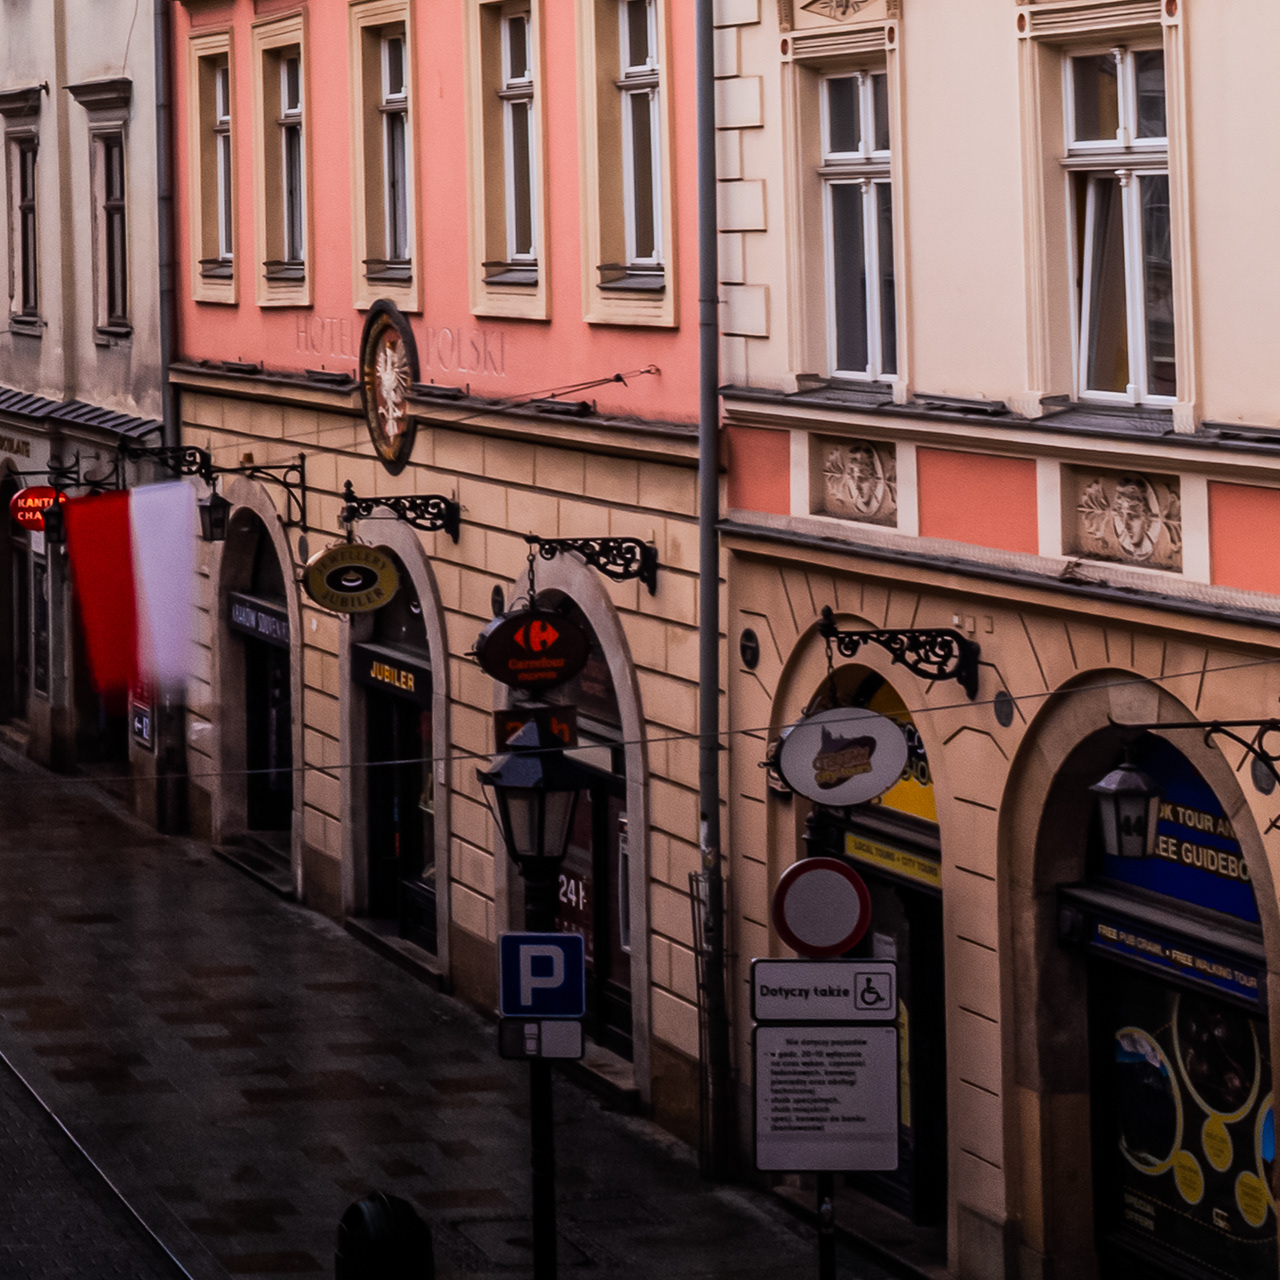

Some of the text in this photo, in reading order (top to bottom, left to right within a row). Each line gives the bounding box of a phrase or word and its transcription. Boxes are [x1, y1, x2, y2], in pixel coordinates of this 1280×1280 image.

[295, 315, 506, 378] HOTEL POLSKI
[320, 587, 386, 608] JUBILER
[370, 661, 416, 692] JUBILER
[506, 717, 570, 743] 2h
[1176, 806, 1215, 833] TOUR
[1216, 818, 1237, 839] AN
[1181, 841, 1250, 881] GUIDEBO
[1097, 923, 1118, 940] FREE
[1171, 949, 1194, 966] FREE
[1194, 955, 1233, 980] WALKING
[1234, 968, 1258, 988] TOUR
[519, 944, 565, 1006] P
[759, 985, 850, 1000] Dotyczy także
